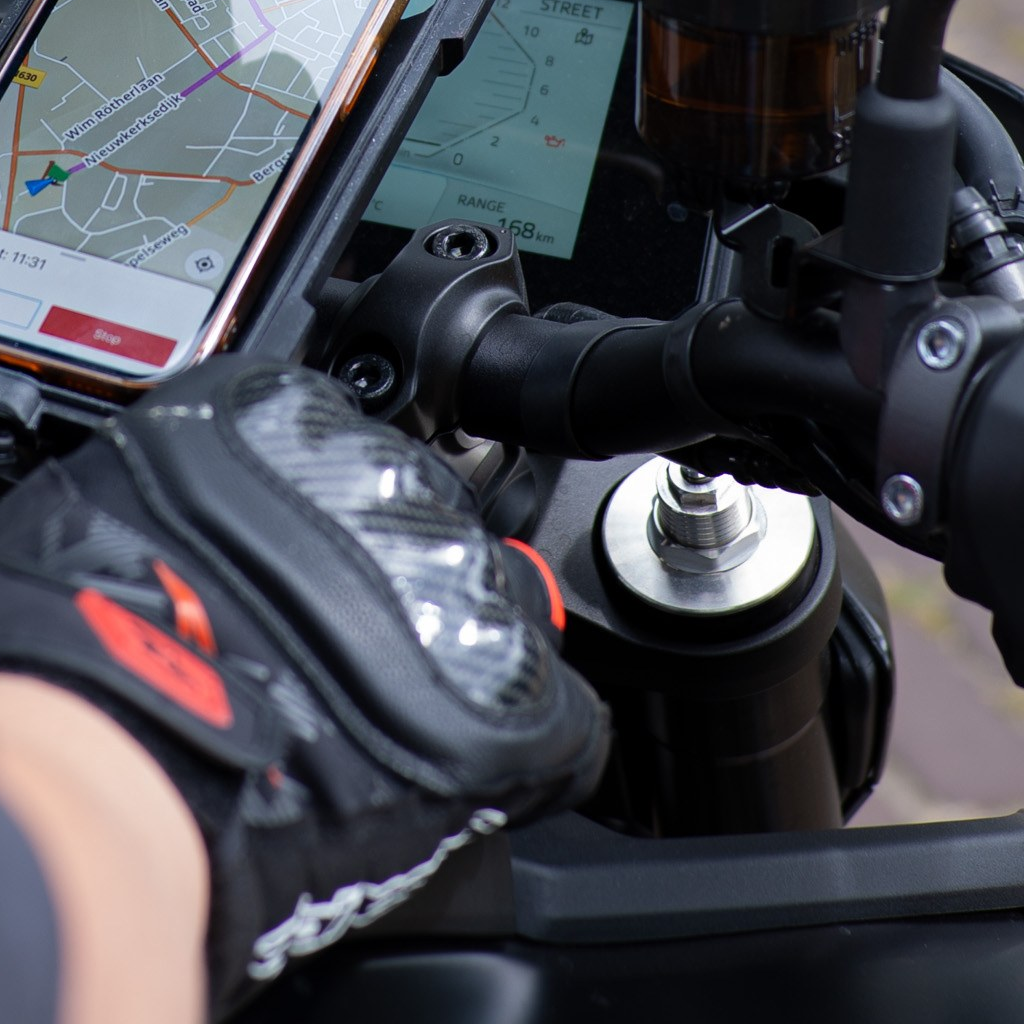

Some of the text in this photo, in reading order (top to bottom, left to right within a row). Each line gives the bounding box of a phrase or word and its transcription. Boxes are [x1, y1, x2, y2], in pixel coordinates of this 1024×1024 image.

[524, 25, 540, 38] 10
[544, 55, 555, 67] 8
[539, 84, 549, 96] 6
[65, 73, 164, 141] Wim Rötherlaan
[530, 115, 540, 127] 4
[84, 93, 183, 167] Nieuwkerksedijk
[490, 136, 500, 148] 2
[453, 152, 464, 166] 0
[457, 194, 507, 214] RANGE
[536, 231, 555, 244] km
[12, 251, 47, 271] 11:31
[93, 328, 122, 346] Stop
